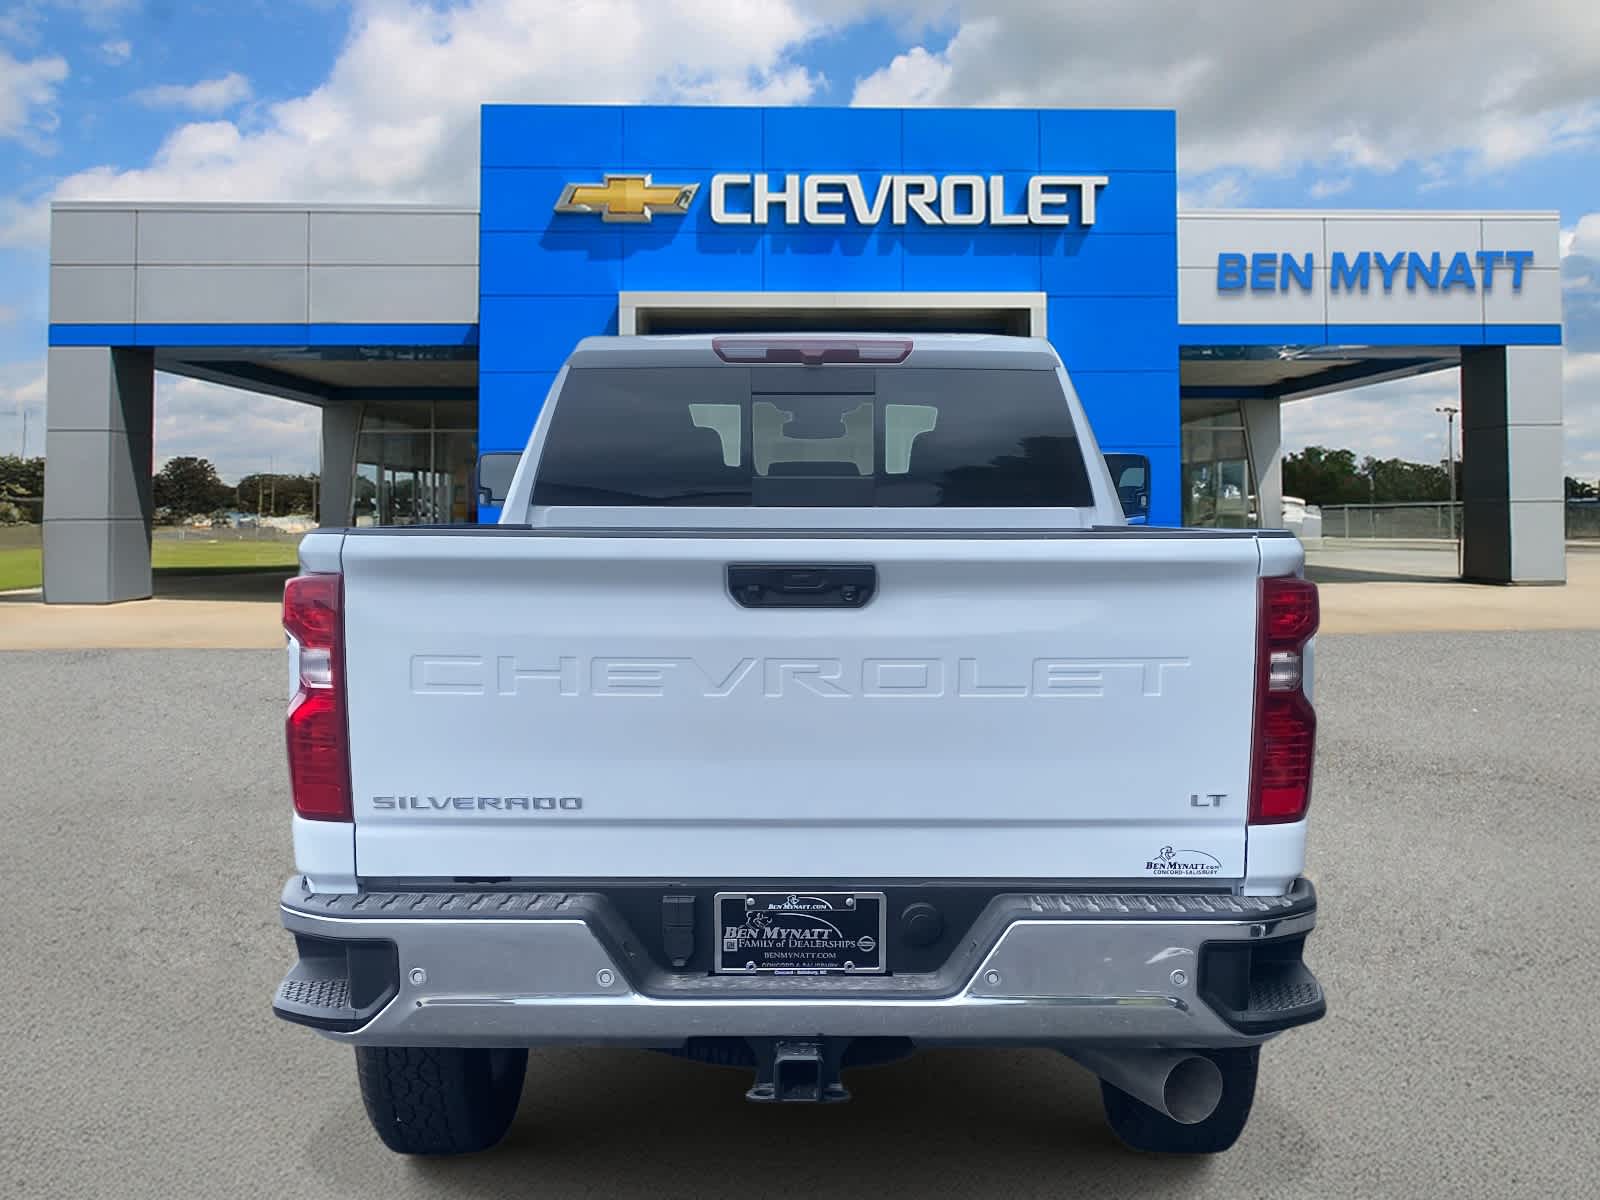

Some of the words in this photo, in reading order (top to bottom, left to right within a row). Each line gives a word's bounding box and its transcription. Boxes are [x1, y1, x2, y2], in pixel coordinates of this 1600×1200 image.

[710, 173, 1109, 225] CHEVROLET
[1217, 252, 1313, 291] BEN
[1330, 251, 1534, 290] MYNATT
[409, 654, 1192, 697] CHEVROLET
[372, 796, 584, 811] SILVERADO
[1190, 794, 1227, 807] LT
[1145, 862, 1166, 870] BEN
[724, 926, 759, 939] BEN
[763, 926, 832, 939] MYNATT
[738, 939, 774, 948] FAMILY
[775, 940, 785, 948] of
[788, 939, 856, 948] DEALERSHIPS
